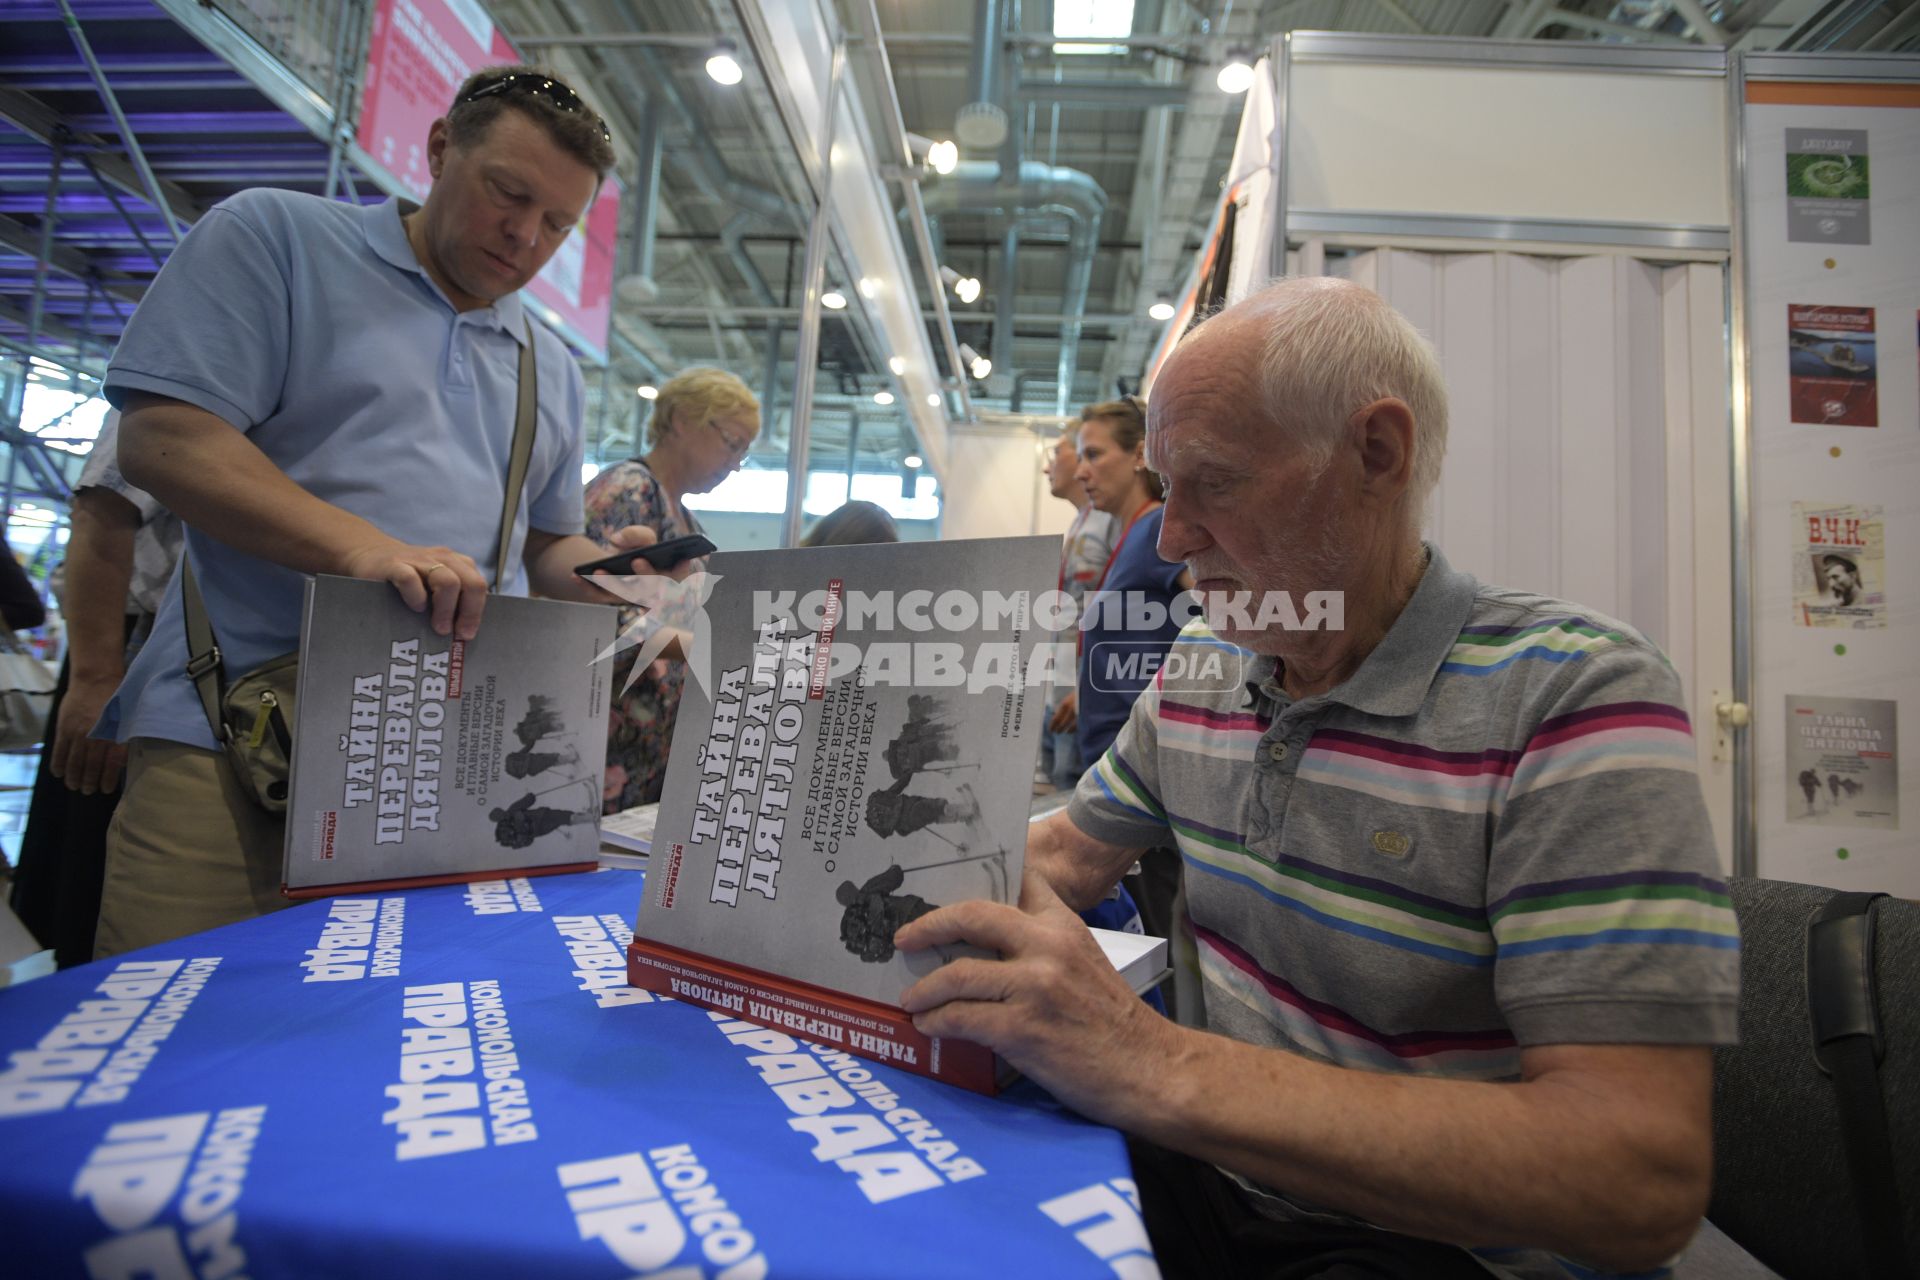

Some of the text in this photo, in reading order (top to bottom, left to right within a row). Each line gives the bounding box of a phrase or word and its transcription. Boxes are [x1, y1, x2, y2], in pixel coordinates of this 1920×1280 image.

[821, 618, 834, 643] ЭТОЙ
[825, 581, 841, 614] КНИГЕ
[811, 656, 828, 697] ТОЛЬКО
[338, 672, 384, 808] ТАЙНА
[375, 638, 419, 845] ПЕРЕВАЛА
[409, 650, 450, 832] ДЯТЛОВА
[455, 691, 471, 789] ВСЕ ДОКУМЕНТЫ
[466, 685, 484, 796] И ГЛАВНЫЕ ВЕРСИИ
[477, 673, 497, 806] О САМОЙ ЗАГАДОЧНОЙ
[490, 698, 506, 782] ИСТОРИИ ВЕКА
[690, 666, 749, 844] ТАЙНА
[710, 617, 788, 908] ПЕРЕВАЛА
[745, 630, 819, 900] ДЯТЛОВА
[801, 689, 836, 840] ВСЕ ДОКУМЕНТЫ
[813, 679, 852, 853] И ГЛАВНЫЕ ВЕРСИИ
[825, 664, 868, 873] О САМОЙ ЗАГАДОЧНОЙ
[845, 701, 878, 837] ИСТОРИИ ВЕКА
[325, 811, 337, 860] ПРАВДА
[665, 844, 684, 908] ПРАВДА
[300, 898, 379, 983] ПРАВДА
[370, 897, 406, 978] КОМСОМОЛЬСКАЯ
[552, 915, 655, 1009] ПРАВДА
[653, 961, 681, 974] ИСТОРИИ
[681, 968, 723, 986] ЗАГАДОЧНОЙ
[670, 977, 745, 1012] ДЯТЛОВА
[724, 980, 749, 993] САМОЙ
[748, 1000, 844, 1042] ПЕРЕВАЛА
[750, 987, 756, 995] О
[756, 989, 783, 1004] ВЕРСИИ
[784, 1000, 819, 1014] ГЛАВНЫЕ
[827, 1012, 877, 1031] ДОКУМЕНТЫ
[0, 958, 186, 1119] ПРАВДА
[73, 956, 224, 1108] КОМСОМОЛЬСКАЯ
[382, 981, 487, 1161] ПРАВДА
[469, 979, 539, 1147] КОМСОМОЛЬСКАЯ
[848, 1029, 917, 1065] ТАЙНА
[878, 1025, 894, 1035] ВСЕ
